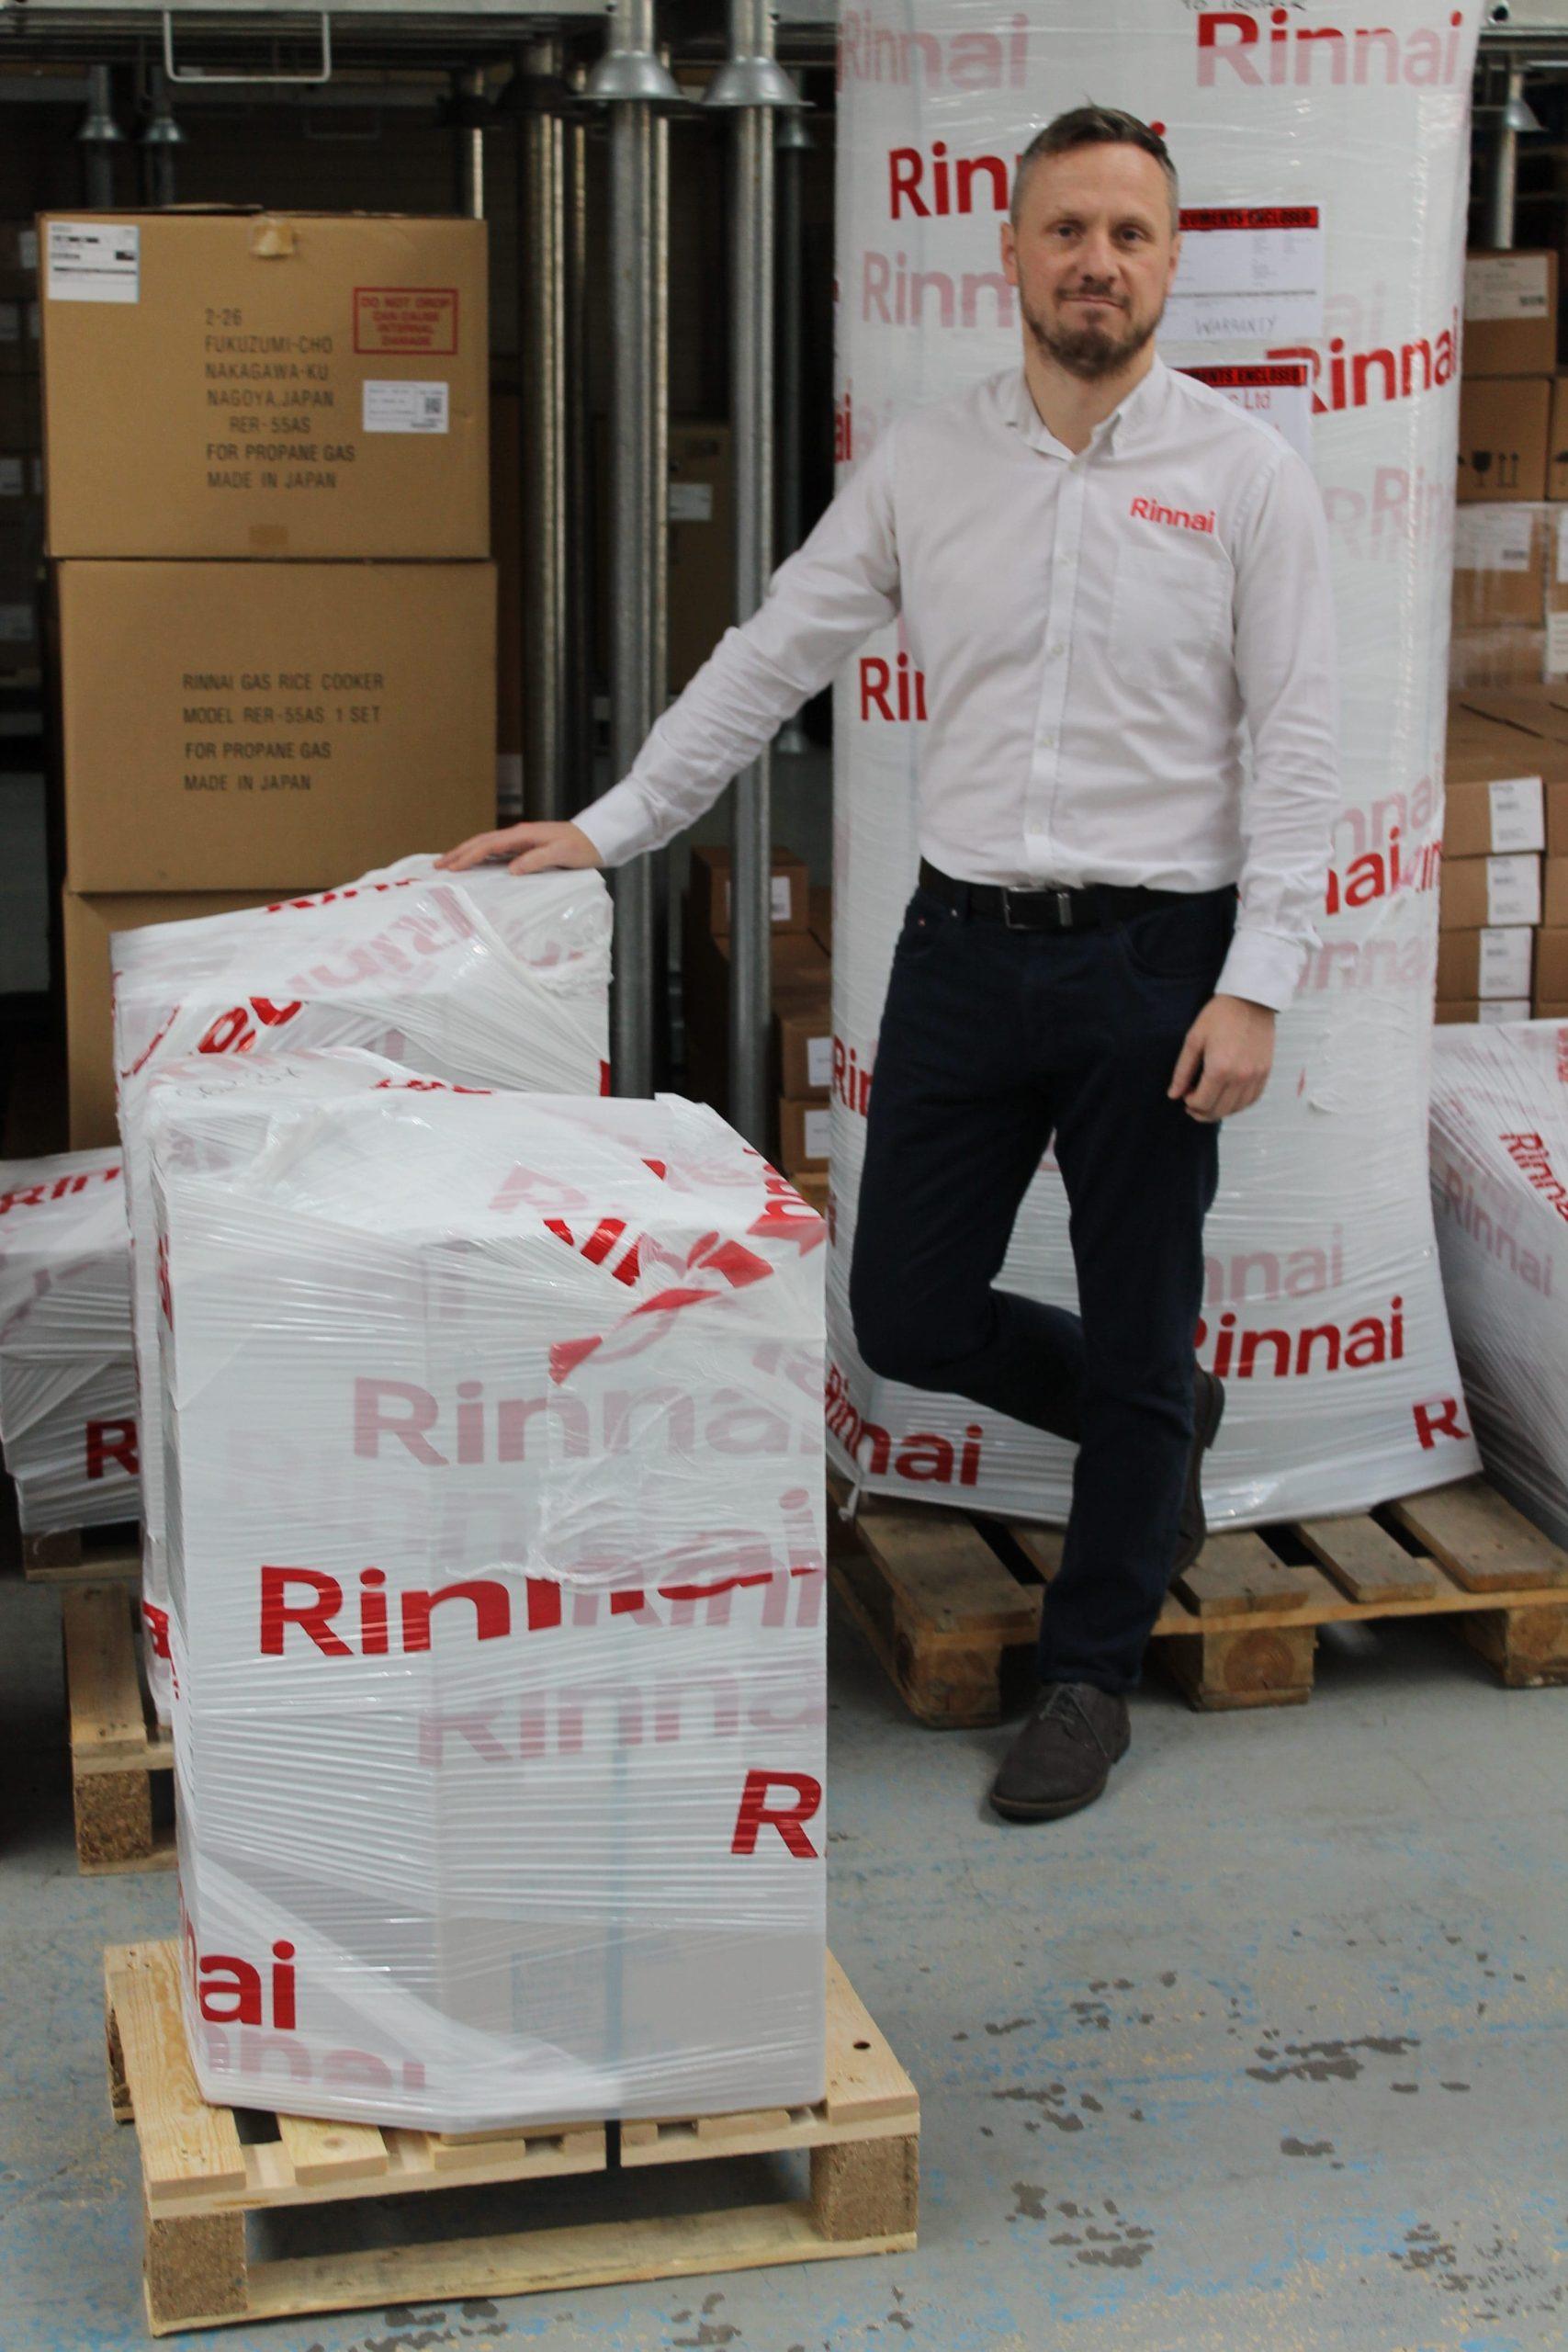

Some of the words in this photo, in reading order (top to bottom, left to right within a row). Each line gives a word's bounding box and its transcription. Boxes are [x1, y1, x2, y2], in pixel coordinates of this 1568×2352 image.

[1197, 7, 1464, 87] Rinnai
[205, 307, 243, 327] 2-26
[205, 334, 333, 355] FUKUZUMI-CHO
[205, 363, 329, 381] NAKAGAWA-KU
[207, 443, 239, 460] FOR
[245, 444, 318, 461] PROPANE
[322, 445, 356, 462] GAS
[207, 471, 251, 489] MADE
[262, 471, 278, 489] IN
[285, 472, 337, 490] JAPAN
[1130, 495, 1215, 533] Rinnai
[183, 673, 234, 690] RINNAI
[241, 674, 271, 690] GAS
[278, 673, 311, 690] RICE
[322, 673, 384, 690] COOKER
[184, 707, 233, 724] MODEL
[350, 706, 380, 724] SET
[185, 742, 217, 760] FOR
[222, 741, 295, 760] PROPANE
[299, 741, 332, 760] GAS
[184, 775, 228, 791] MADE
[237, 775, 254, 791] IN
[260, 775, 311, 791] JAPAN
[731, 1770, 822, 1859] R
